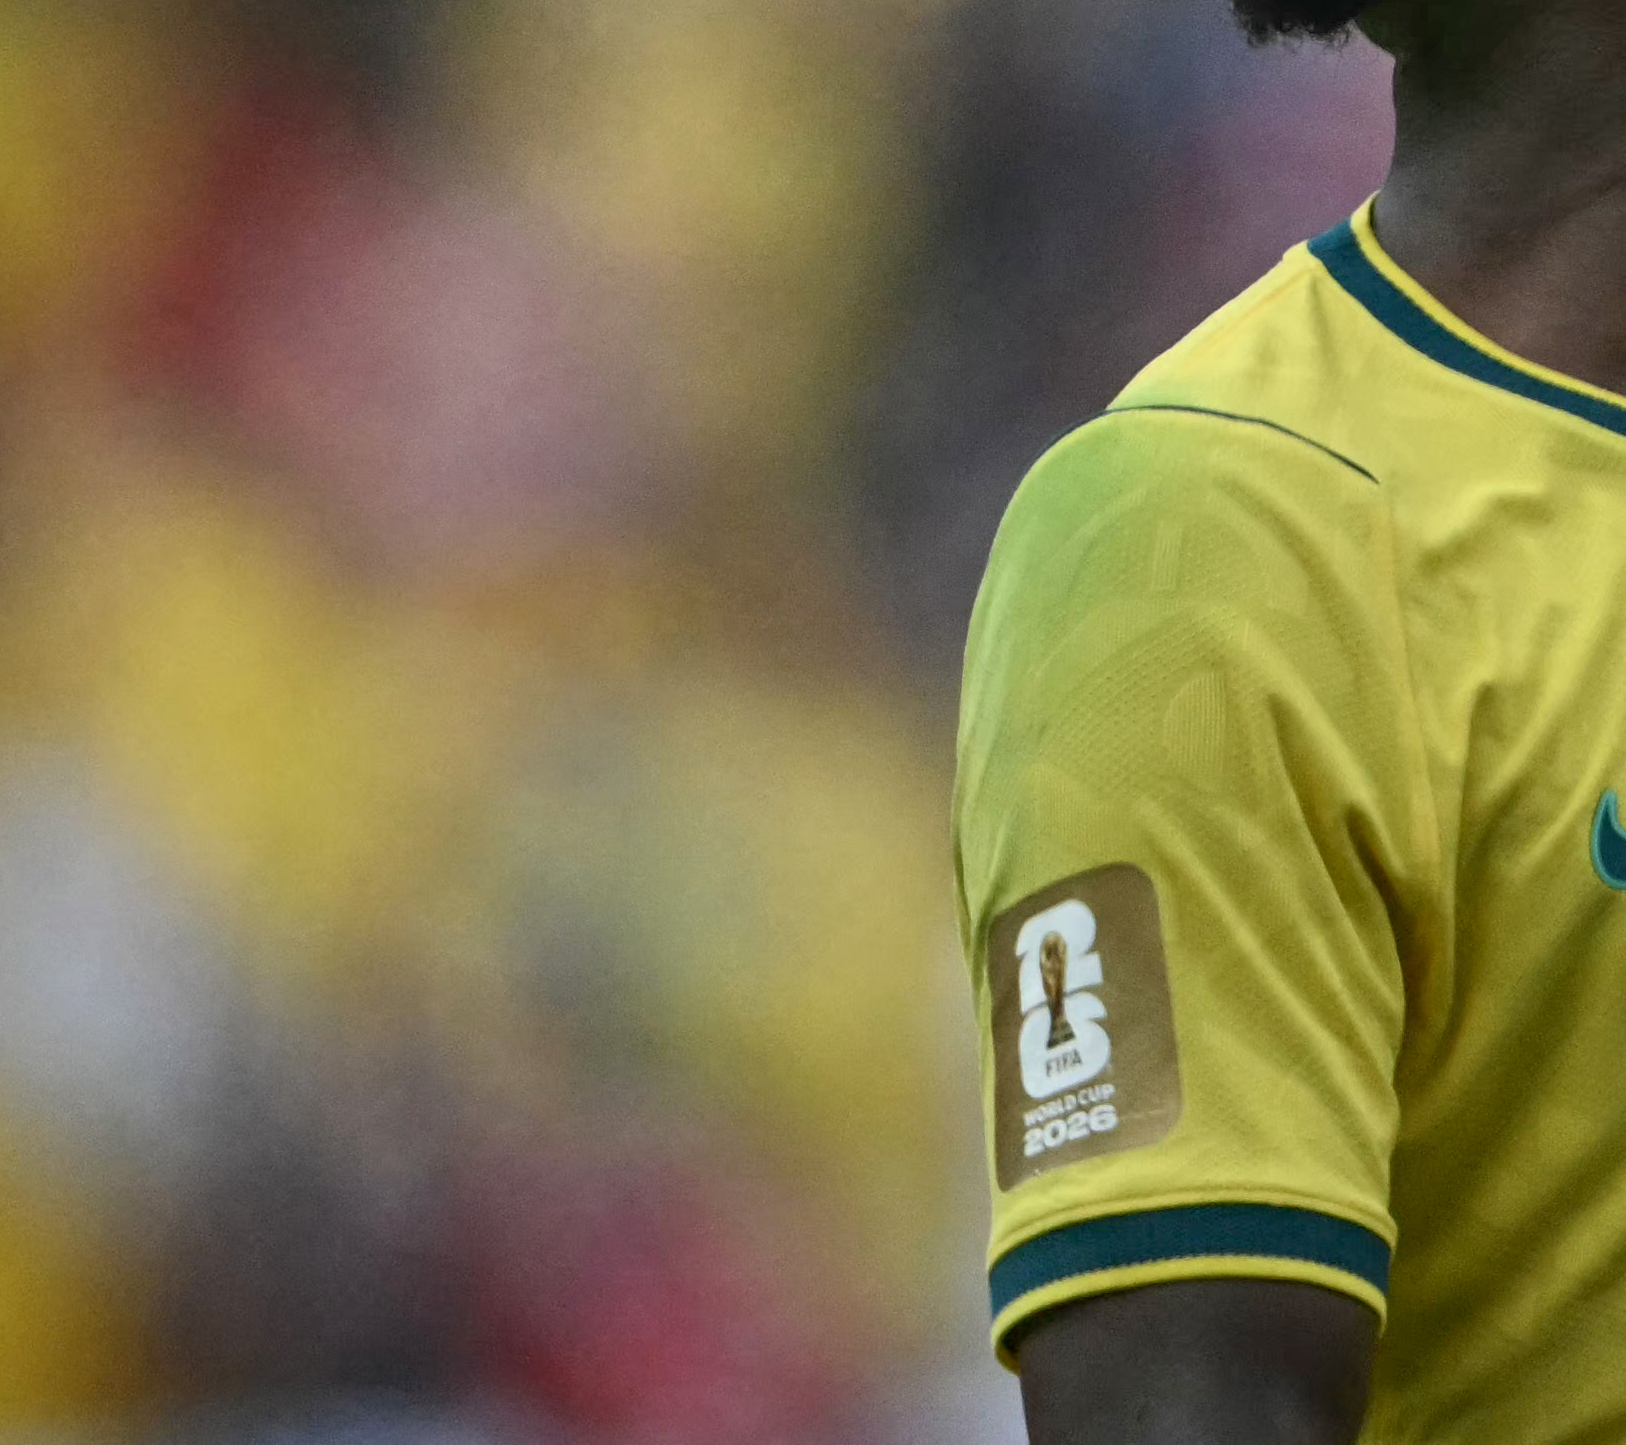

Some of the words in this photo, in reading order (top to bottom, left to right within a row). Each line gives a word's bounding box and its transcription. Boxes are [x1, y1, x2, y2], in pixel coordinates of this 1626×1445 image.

[1045, 1049, 1083, 1078] FIFA
[1024, 1094, 1077, 1127] WORLD
[1077, 1083, 1116, 1106] CUP
[1024, 1104, 1118, 1158] 2026
